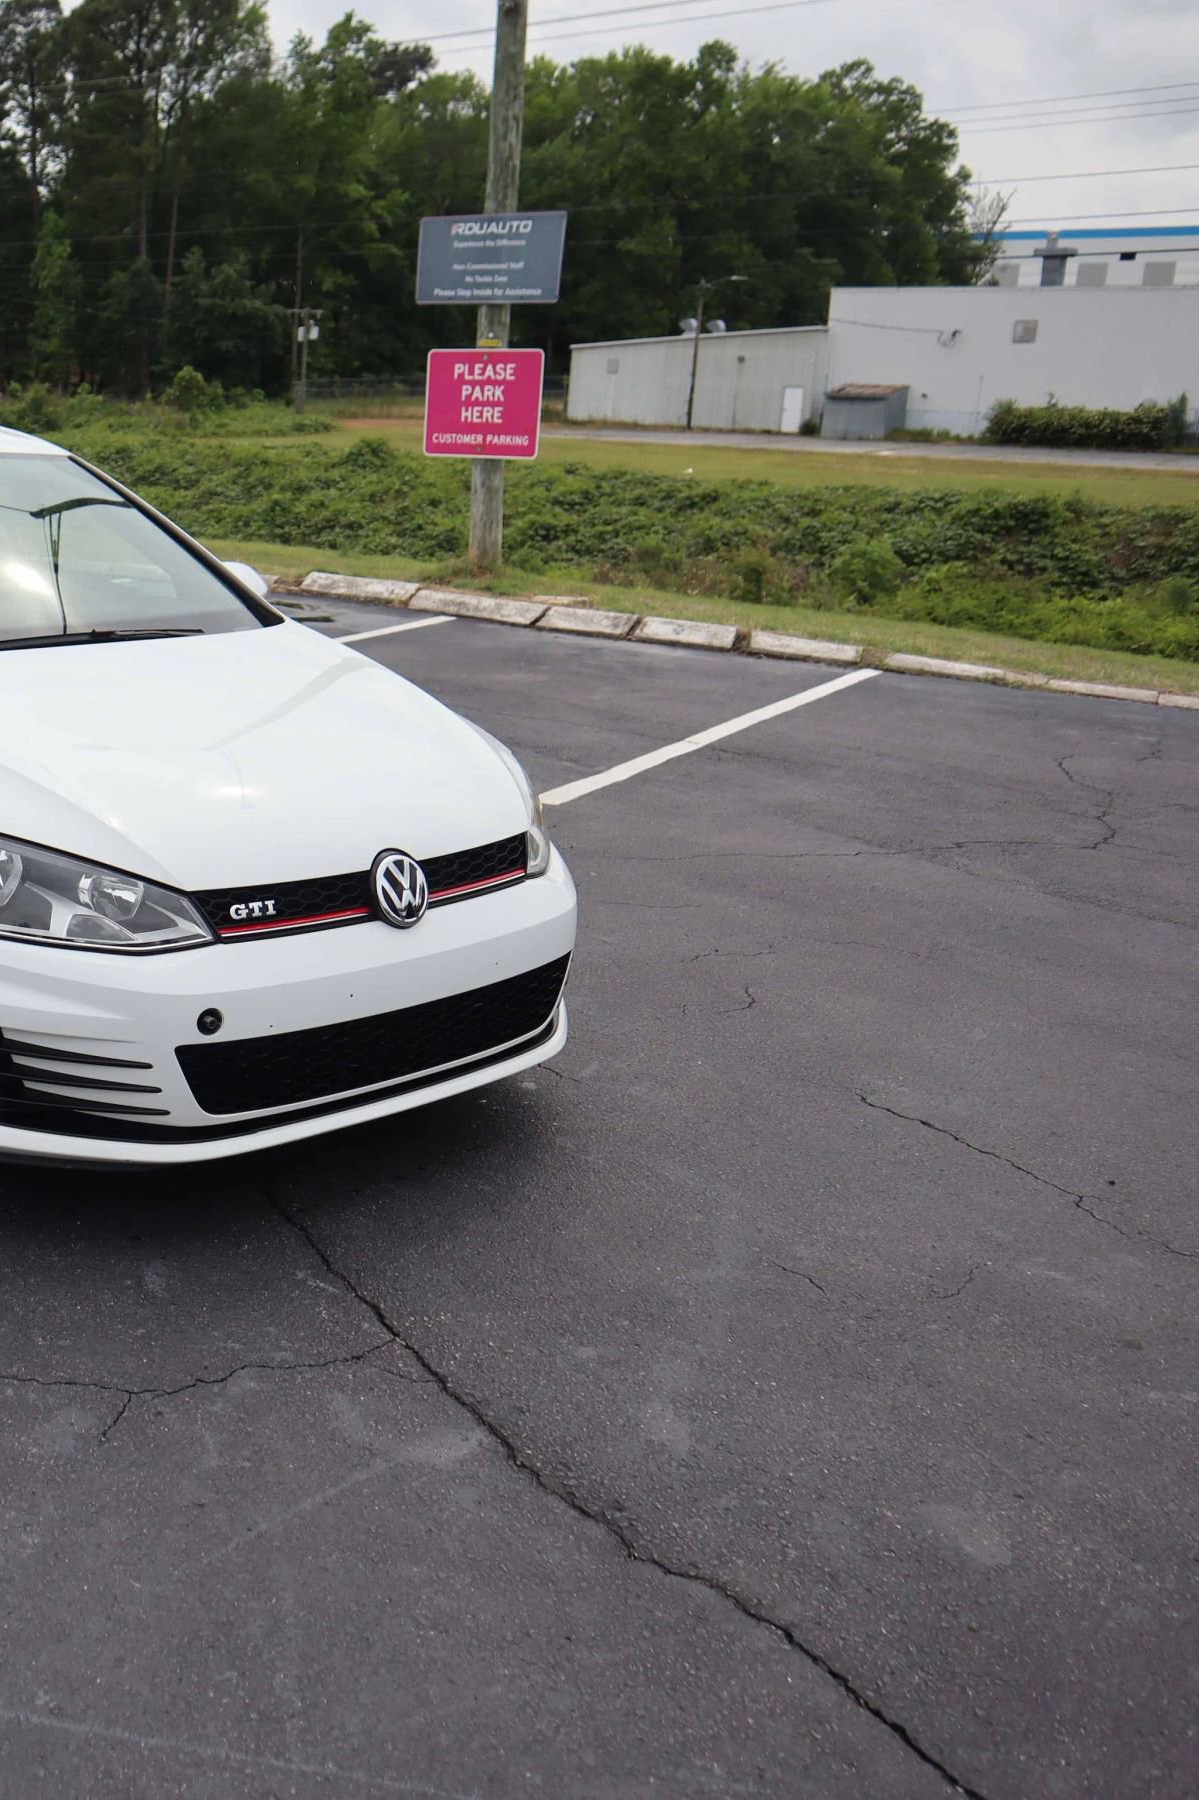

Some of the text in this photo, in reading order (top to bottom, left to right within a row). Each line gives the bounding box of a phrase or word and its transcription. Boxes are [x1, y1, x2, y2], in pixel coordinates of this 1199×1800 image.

[433, 287, 456, 296] Please
[504, 286, 543, 296] Assistance
[453, 363, 516, 381] PLEASE
[461, 385, 505, 402] PARK
[460, 406, 504, 424] HERE
[432, 432, 529, 447] CUSTOMER PARKING
[229, 899, 277, 921] GTI
